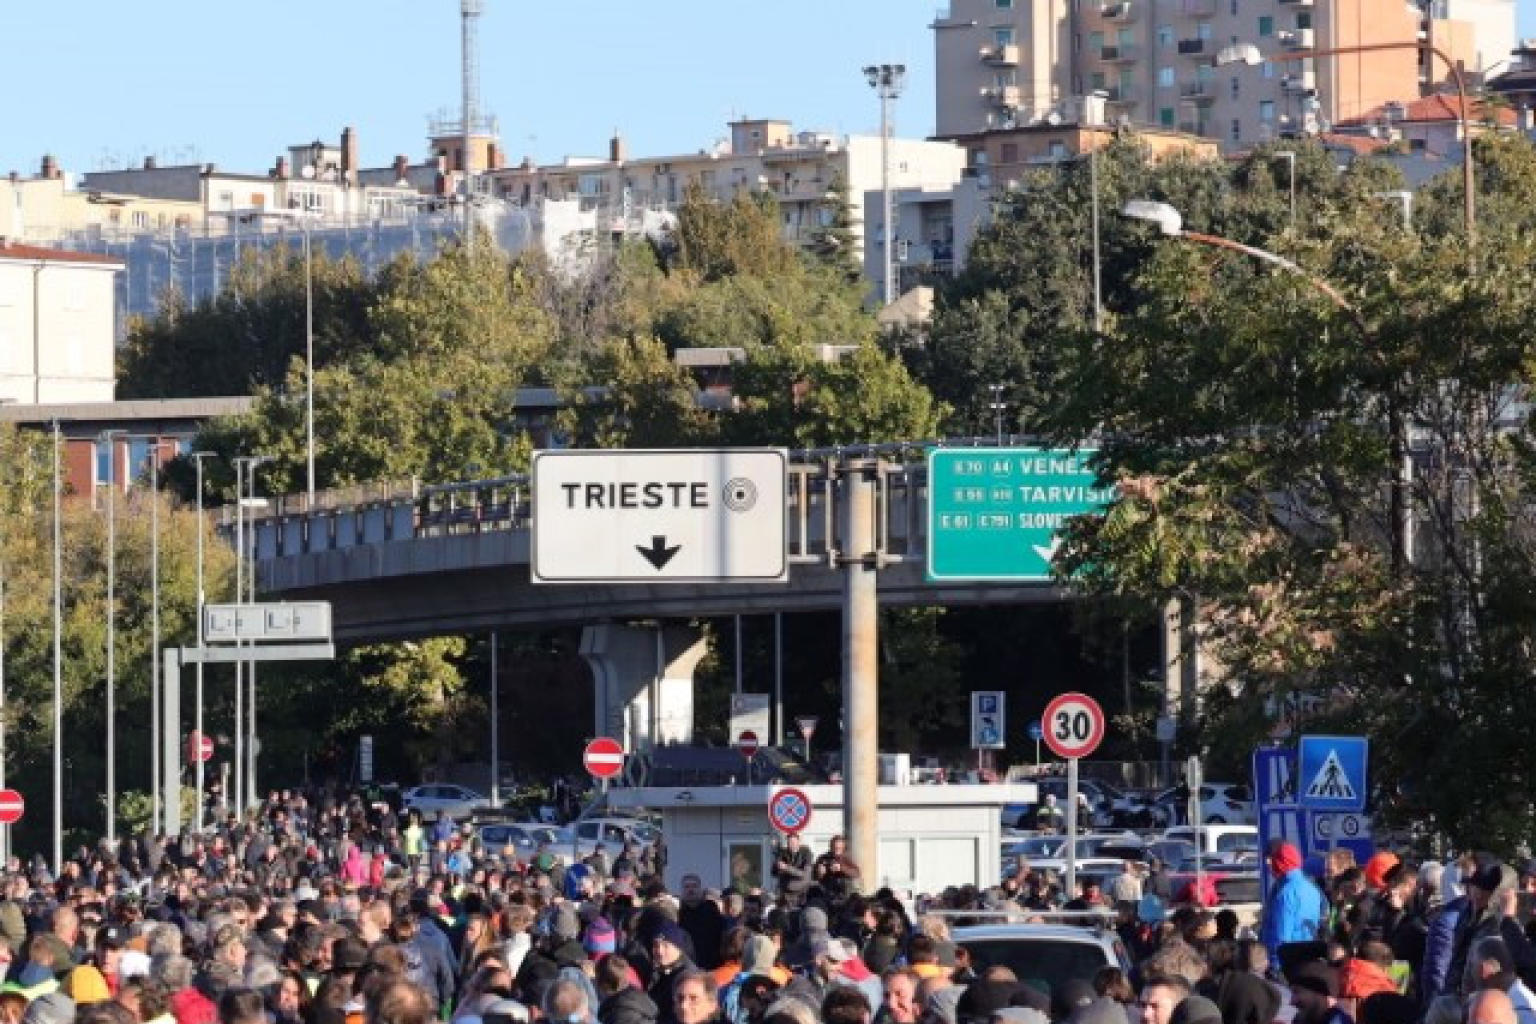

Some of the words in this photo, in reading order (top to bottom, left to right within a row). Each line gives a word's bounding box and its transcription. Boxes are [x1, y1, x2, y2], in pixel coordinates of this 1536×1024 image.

[1019, 457, 1094, 474] VENEZ
[561, 481, 709, 509] TRIESTE
[1055, 710, 1090, 740] 30
